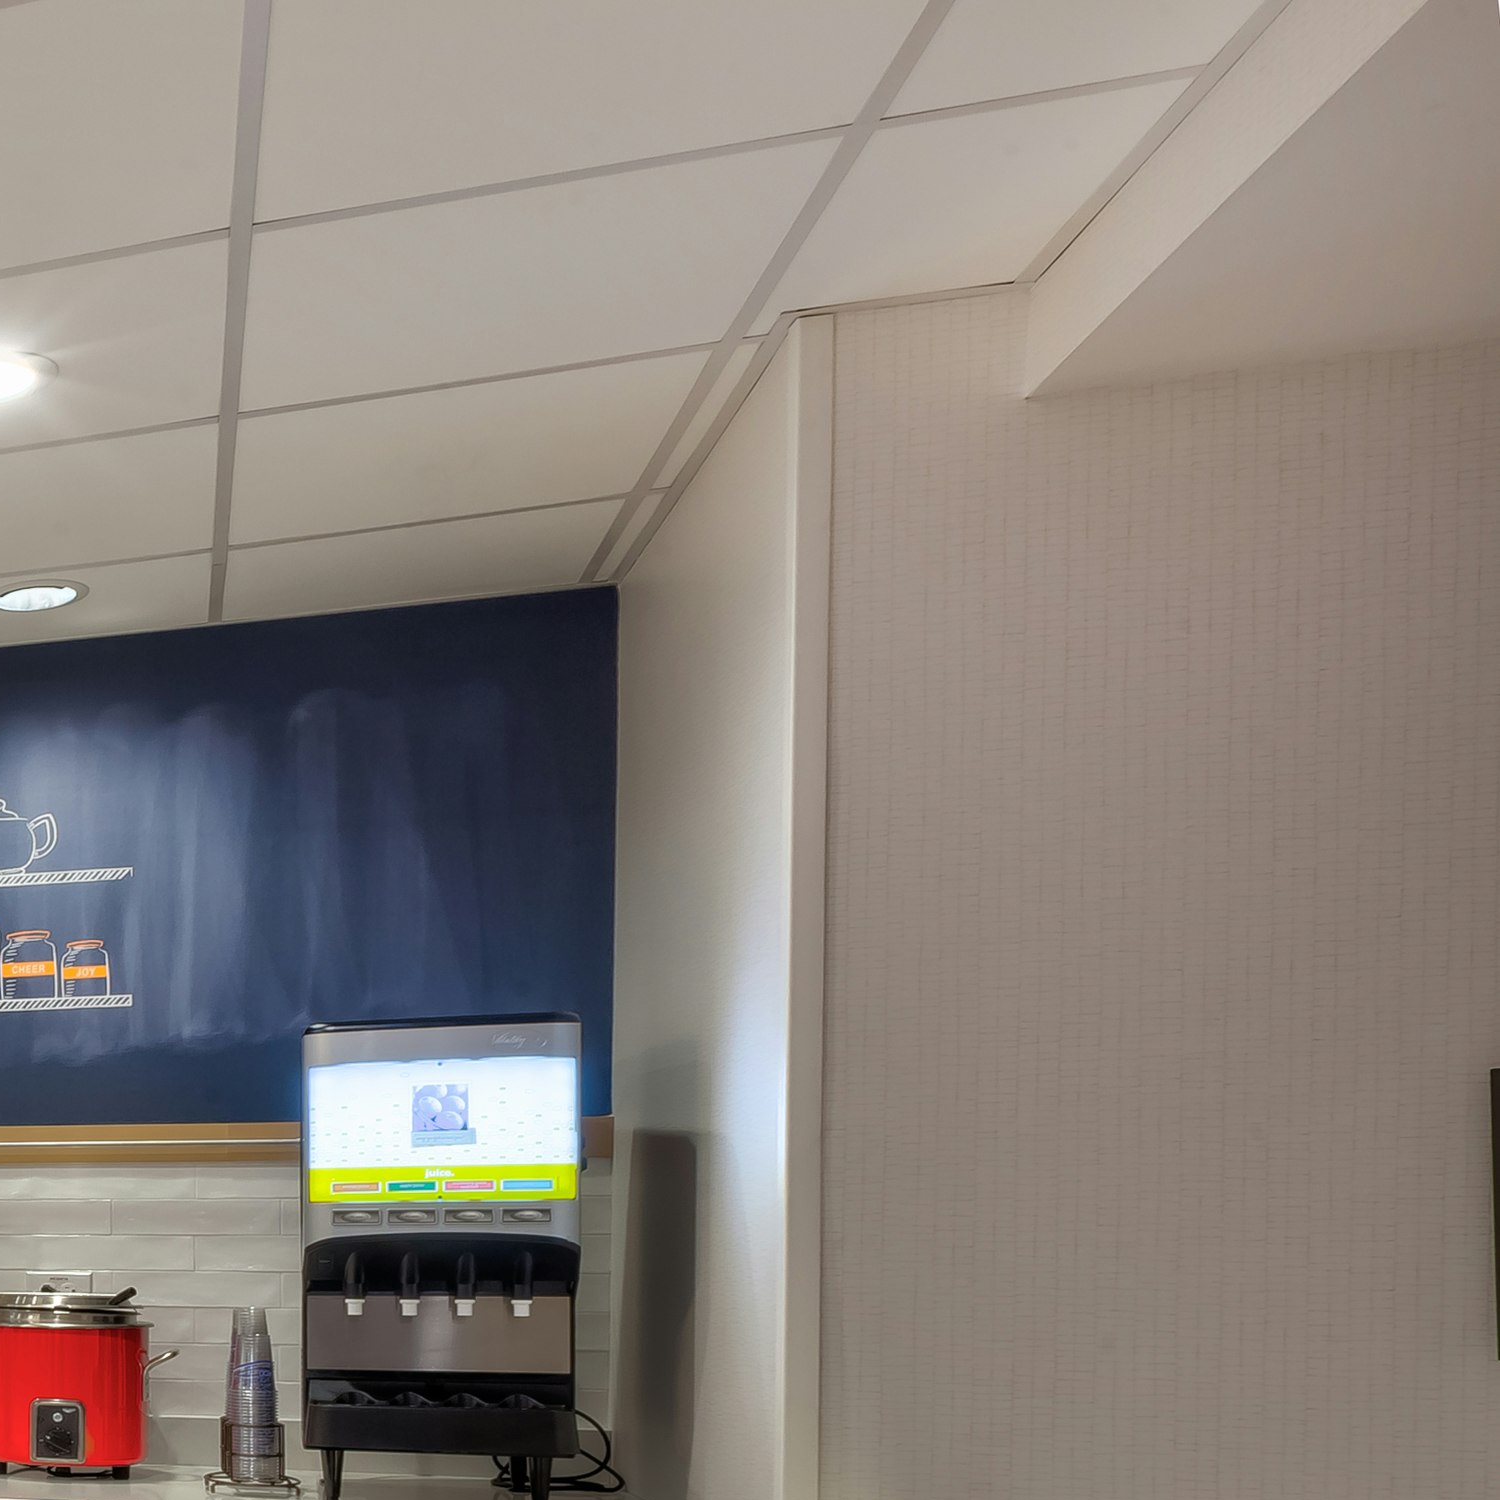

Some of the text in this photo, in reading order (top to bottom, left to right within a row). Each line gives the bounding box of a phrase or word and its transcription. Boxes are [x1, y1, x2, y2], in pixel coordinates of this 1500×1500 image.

[11, 964, 46, 975] CHEER
[75, 967, 96, 977] JOY
[424, 1168, 456, 1179] juice.
